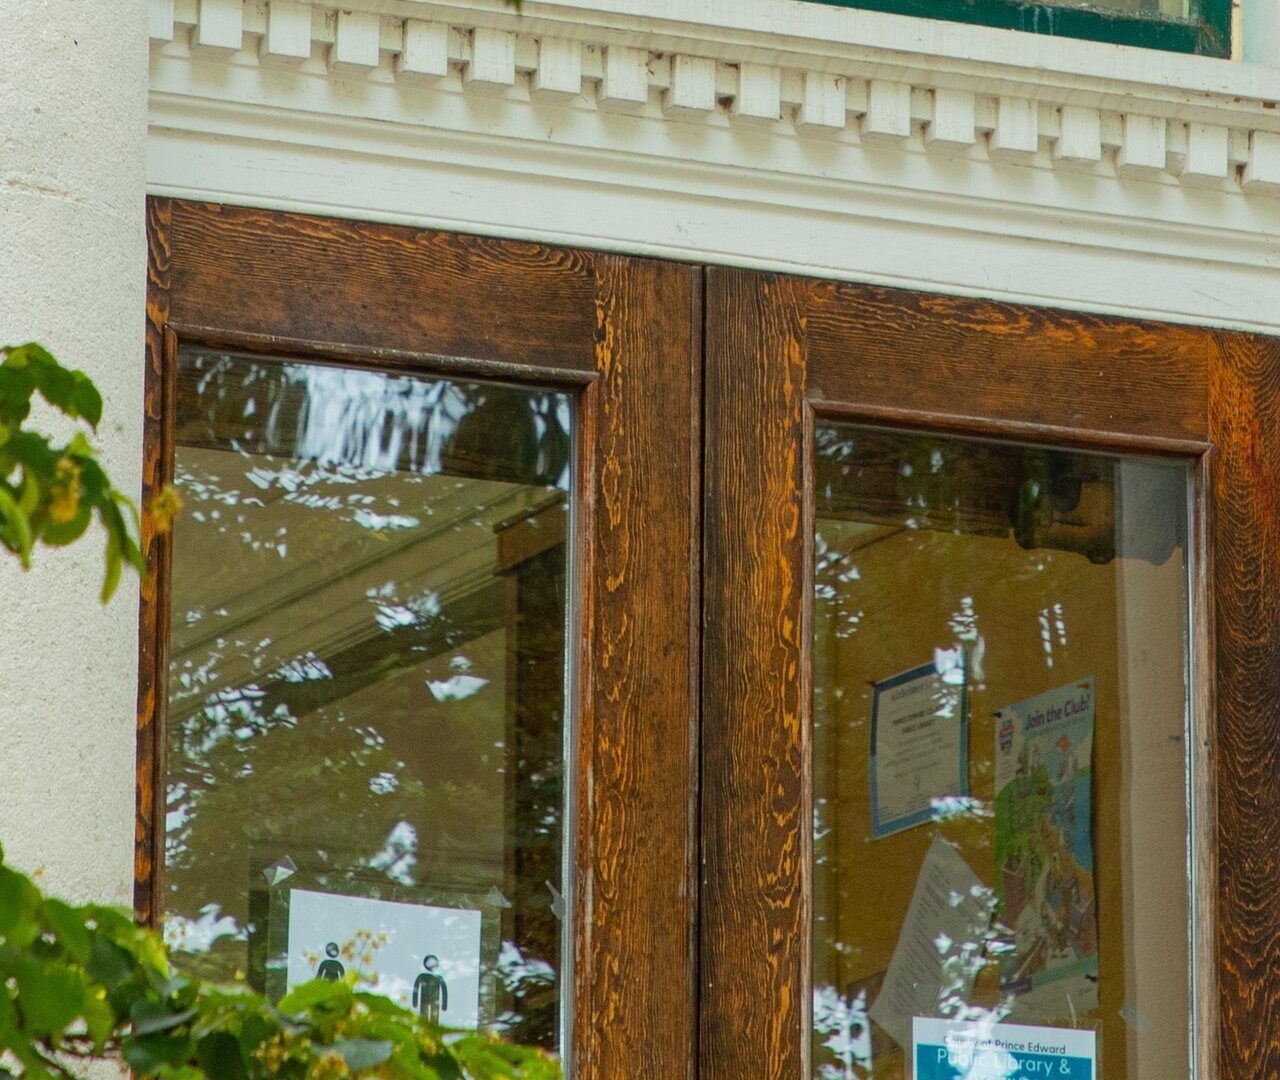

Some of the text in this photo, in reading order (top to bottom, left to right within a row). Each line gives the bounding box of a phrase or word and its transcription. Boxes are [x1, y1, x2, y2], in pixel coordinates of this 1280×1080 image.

[1024, 710, 1045, 731] Join
[1046, 704, 1063, 723] the
[994, 1039, 1025, 1052] Prince
[1028, 1042, 1066, 1055] Edward
[994, 1051, 1053, 1077] Library
[1059, 1058, 1072, 1074] &
